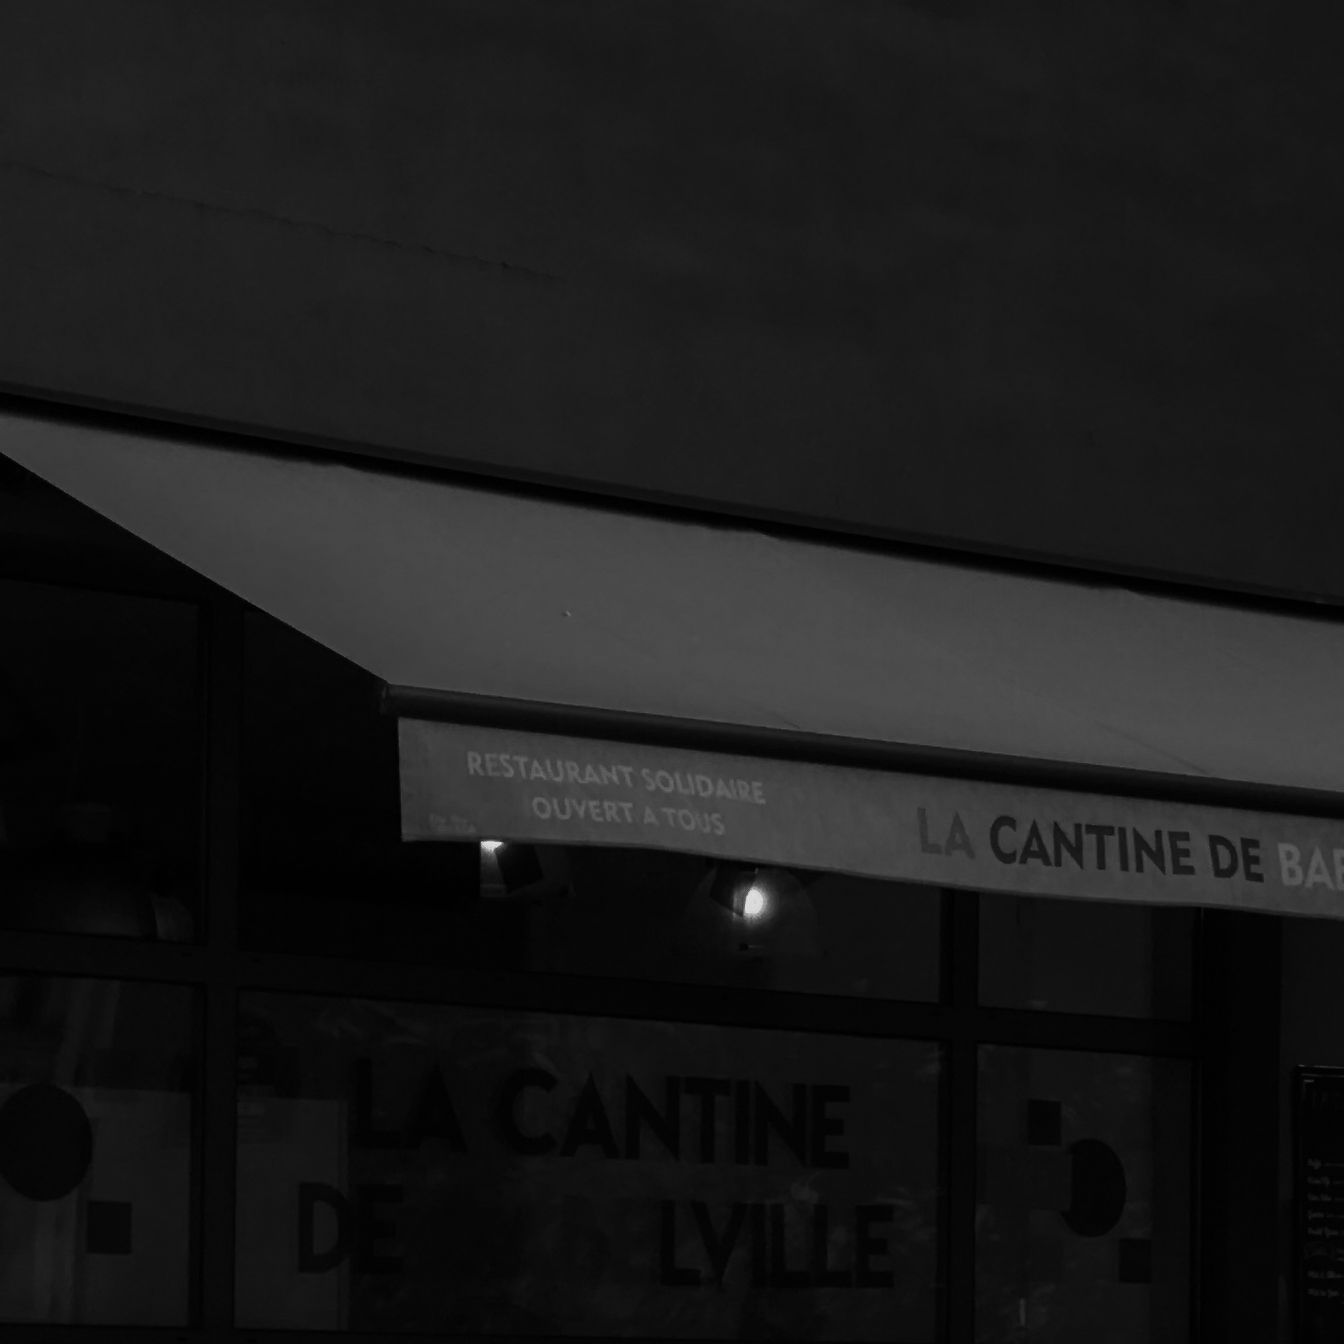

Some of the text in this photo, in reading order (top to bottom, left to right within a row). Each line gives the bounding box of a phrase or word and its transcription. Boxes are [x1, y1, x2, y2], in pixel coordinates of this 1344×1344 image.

[466, 750, 766, 805] RESTAURANT SOLIDAIRE
[532, 796, 633, 823] OUVERT
[662, 807, 726, 836] TOUS
[917, 807, 975, 860] LA
[990, 815, 1196, 876] CANTINE
[1209, 834, 1265, 883] DE
[354, 1057, 851, 1169] LA CANTINE
[298, 1182, 403, 1274] DE
